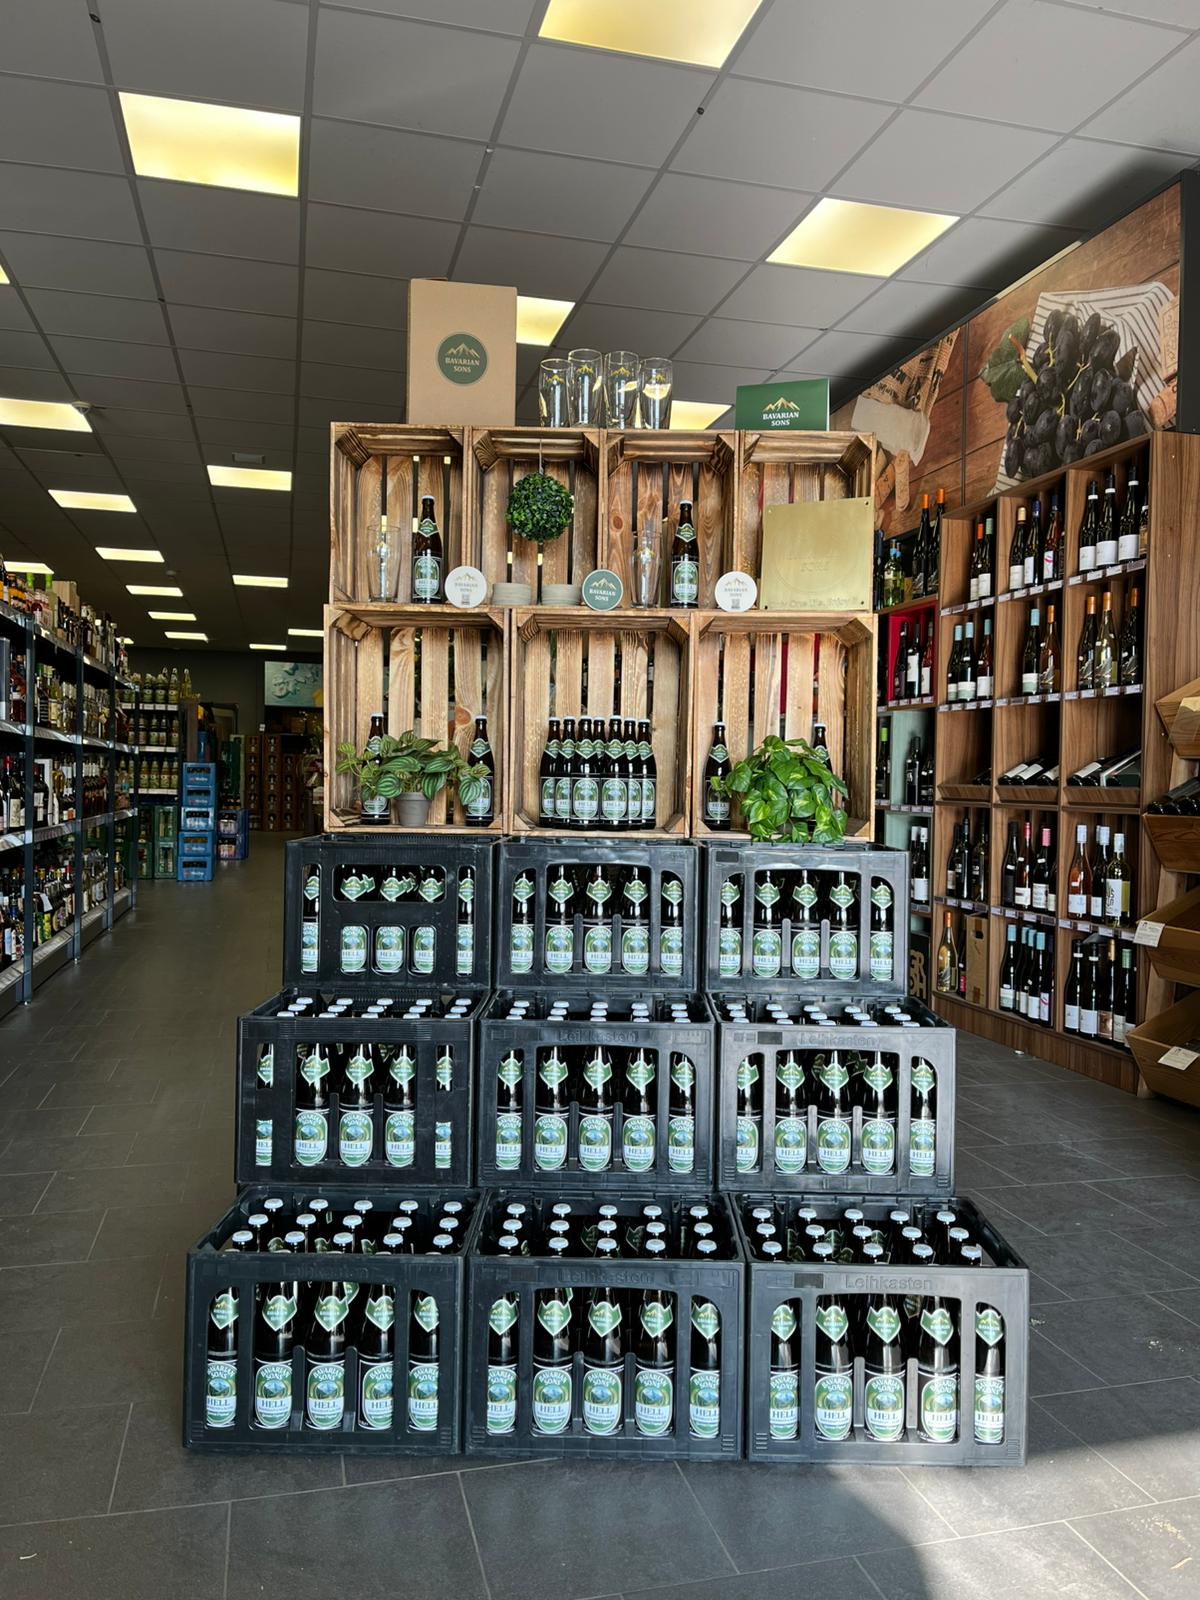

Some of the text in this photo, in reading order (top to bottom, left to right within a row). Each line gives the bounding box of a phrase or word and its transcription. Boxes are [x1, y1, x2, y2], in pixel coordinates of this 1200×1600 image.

[445, 357, 480, 366] BAVARIAN
[762, 411, 800, 420] BAVARIAN
[771, 419, 790, 427] SONS
[589, 588, 616, 596] BAVARIAN
[845, 1275, 933, 1290] Leihkasten
[640, 1407, 662, 1415] HELL
